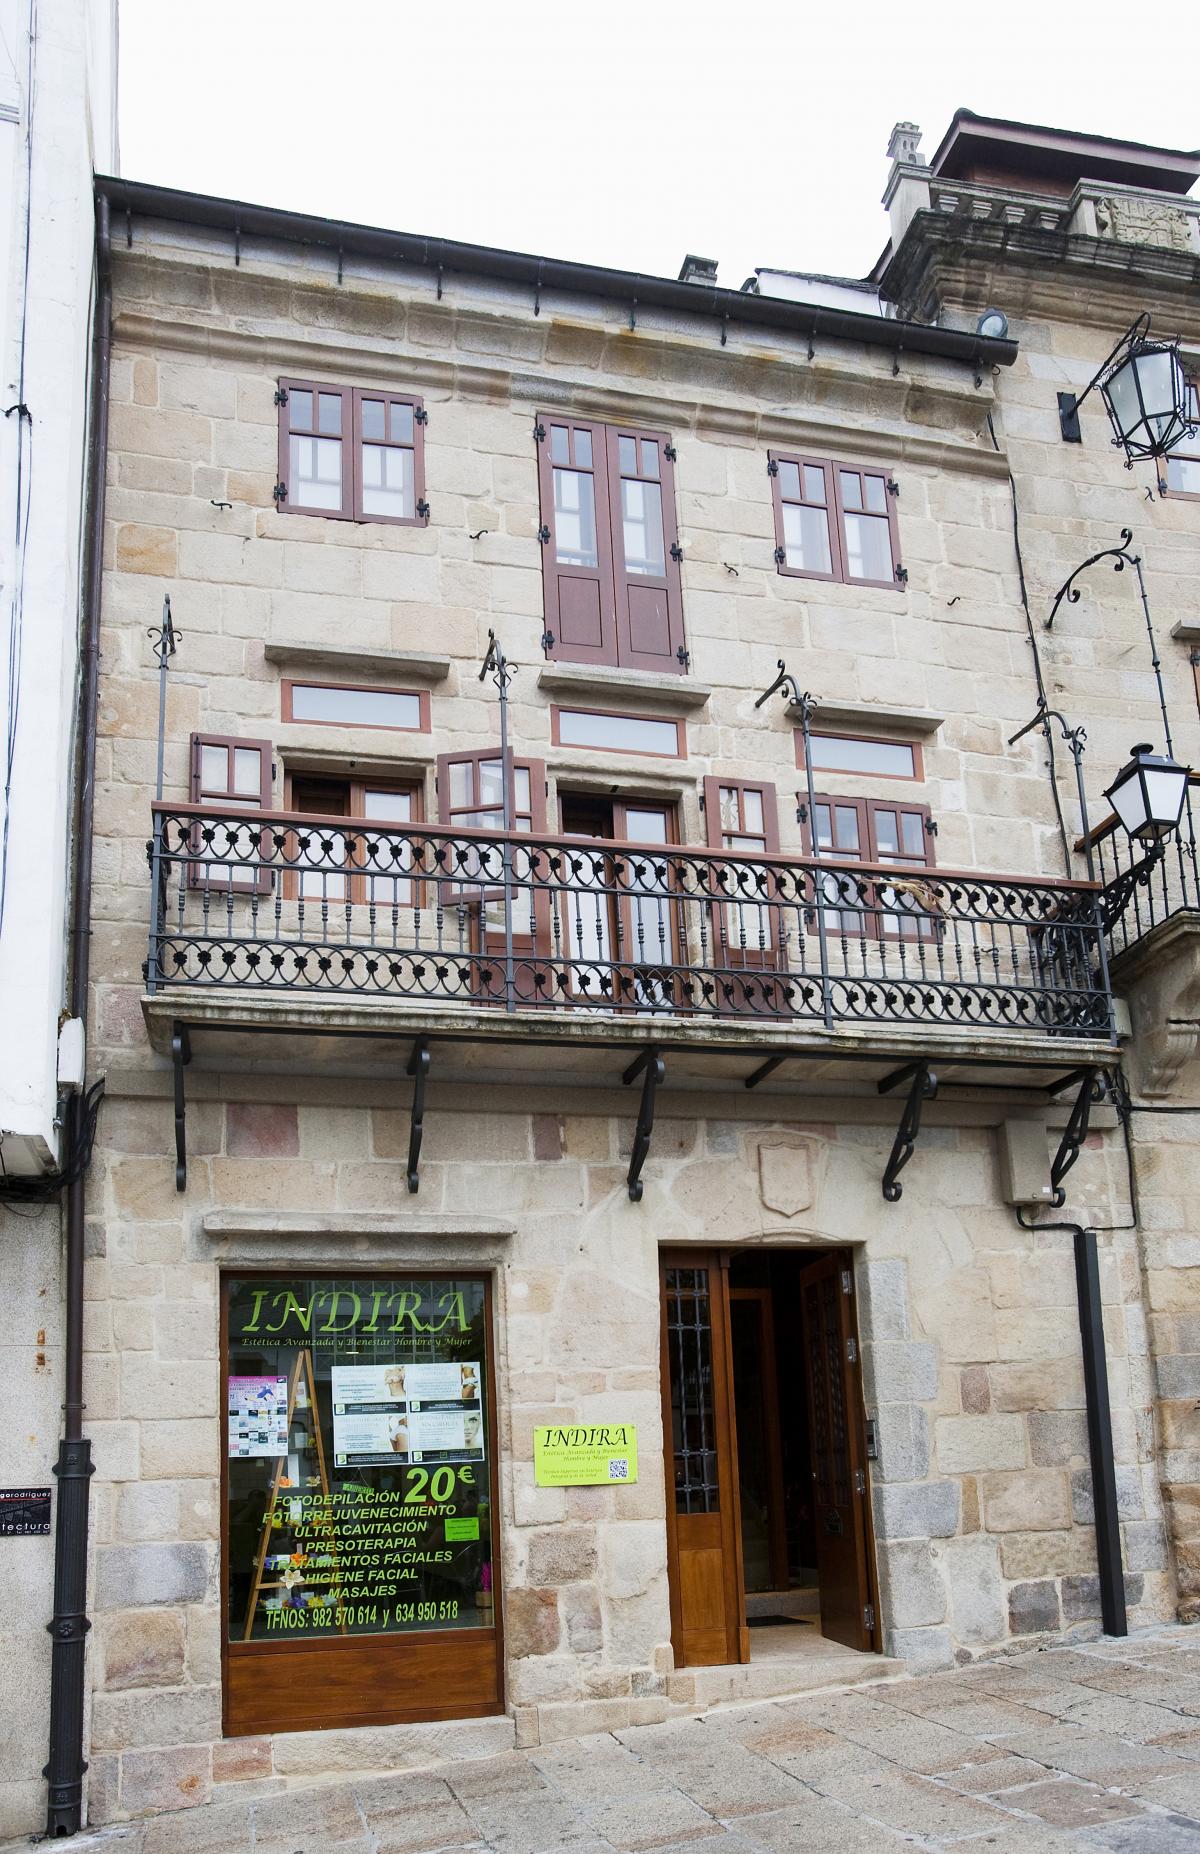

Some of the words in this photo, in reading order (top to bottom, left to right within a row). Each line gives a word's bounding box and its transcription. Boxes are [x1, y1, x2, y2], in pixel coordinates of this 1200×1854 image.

[241, 1290, 472, 1332] INDIRA
[242, 1337, 281, 1347] Estética
[283, 1338, 335, 1347] Avanzada
[338, 1340, 344, 1349] y
[346, 1338, 391, 1347] Bienestar
[394, 1338, 433, 1347] Hombre
[435, 1340, 441, 1348] y
[444, 1337, 473, 1347] Mujer
[543, 1427, 629, 1448] INDIRA
[404, 1465, 475, 1503] 20€
[273, 1489, 400, 1507] FOTODEPILACIÓN
[262, 1504, 457, 1524] FOTORREJUVENECIMIENTO
[294, 1519, 428, 1538] ULTRACAVITACIÓN
[305, 1537, 417, 1553] PRESOTERAPIA
[269, 1554, 380, 1571] TRATAMIENTOS
[383, 1550, 453, 1565] FACIALES
[305, 1571, 365, 1584] HIGIENE
[367, 1568, 419, 1581] FACIAL
[328, 1585, 397, 1599] MASAJES
[312, 1607, 333, 1628] 982
[335, 1606, 355, 1626] 570
[357, 1605, 377, 1625] 614
[382, 1609, 390, 1629] y
[395, 1602, 415, 1623] 634
[417, 1601, 437, 1621] 950
[439, 1600, 459, 1620] 518
